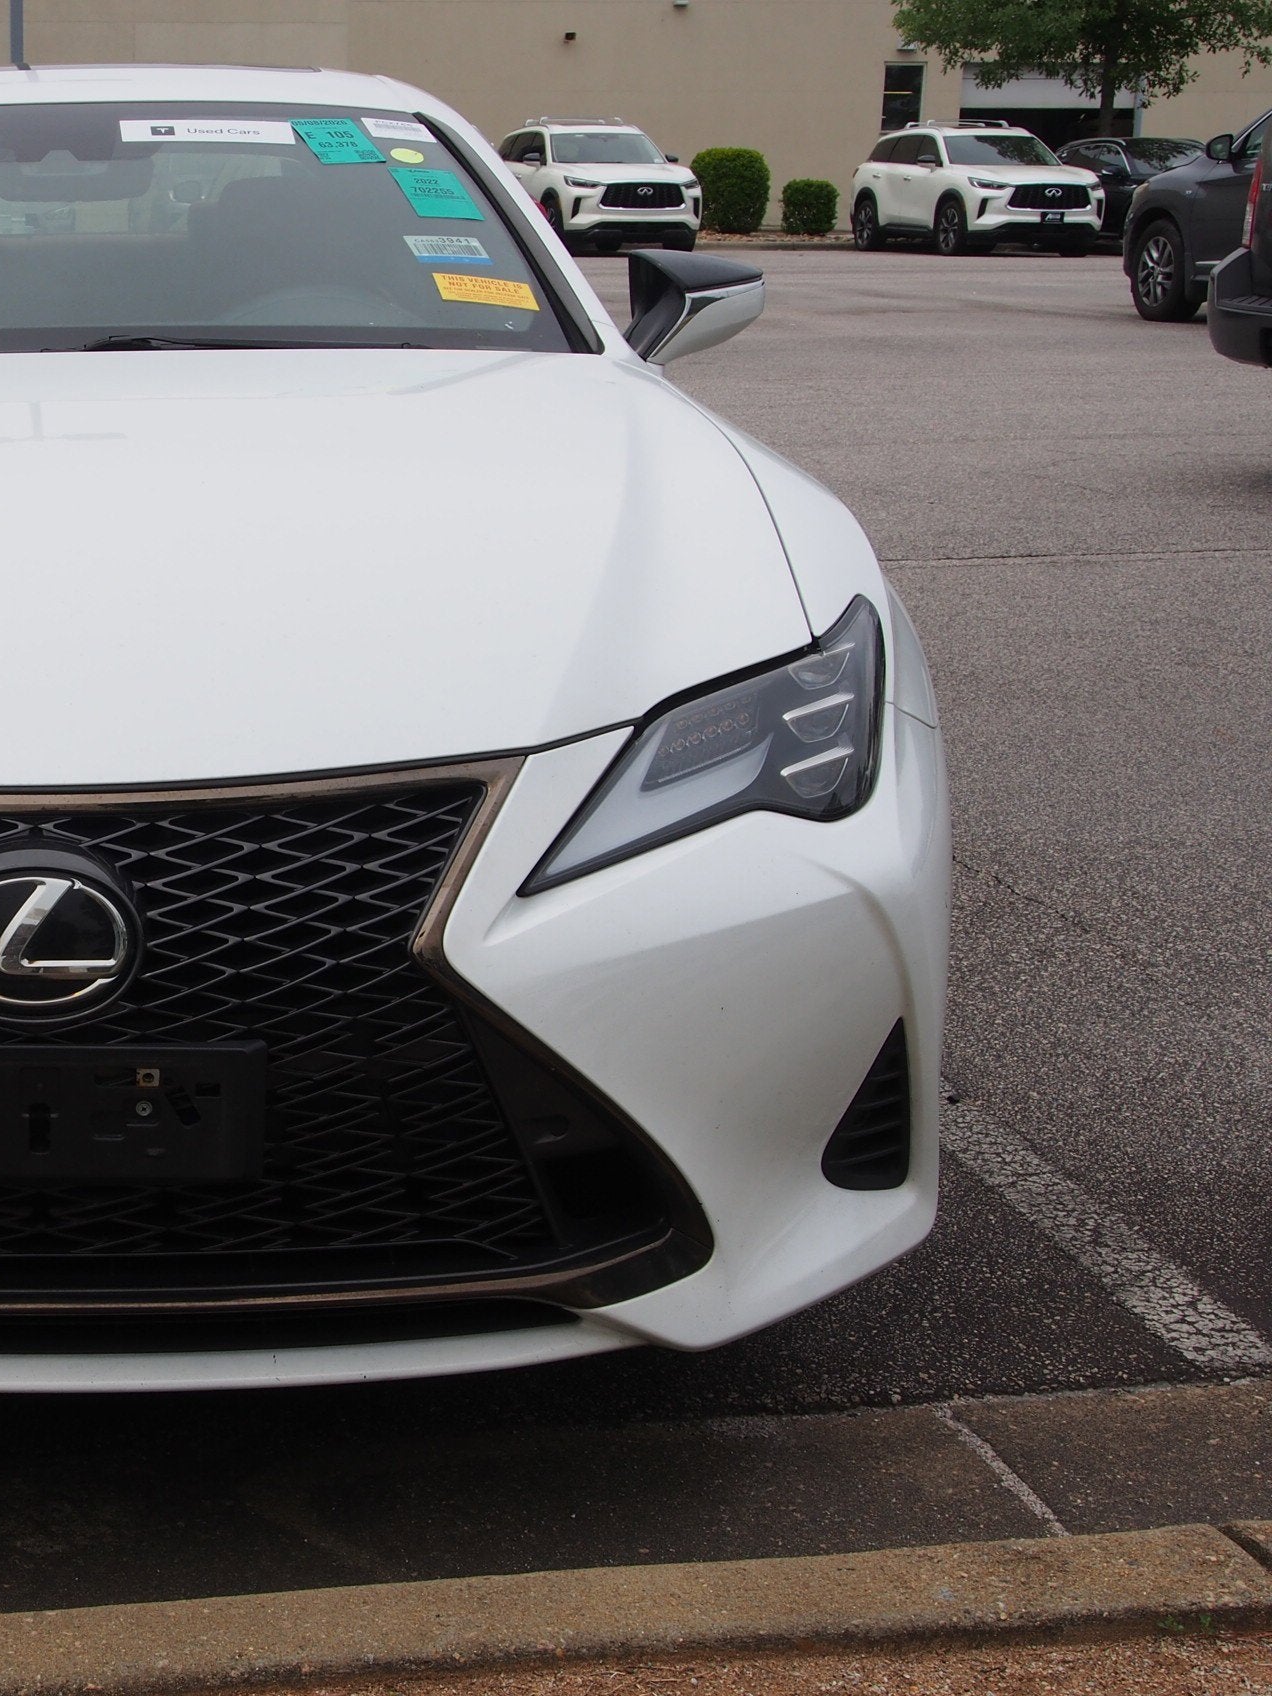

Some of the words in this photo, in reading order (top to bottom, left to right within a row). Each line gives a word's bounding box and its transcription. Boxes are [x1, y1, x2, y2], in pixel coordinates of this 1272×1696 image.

[187, 127, 223, 135] Used
[227, 128, 261, 136] Cars
[305, 131, 316, 139] E
[326, 131, 354, 139] 105
[468, 278, 509, 286] VEHICLE
[494, 286, 520, 294] SALE
